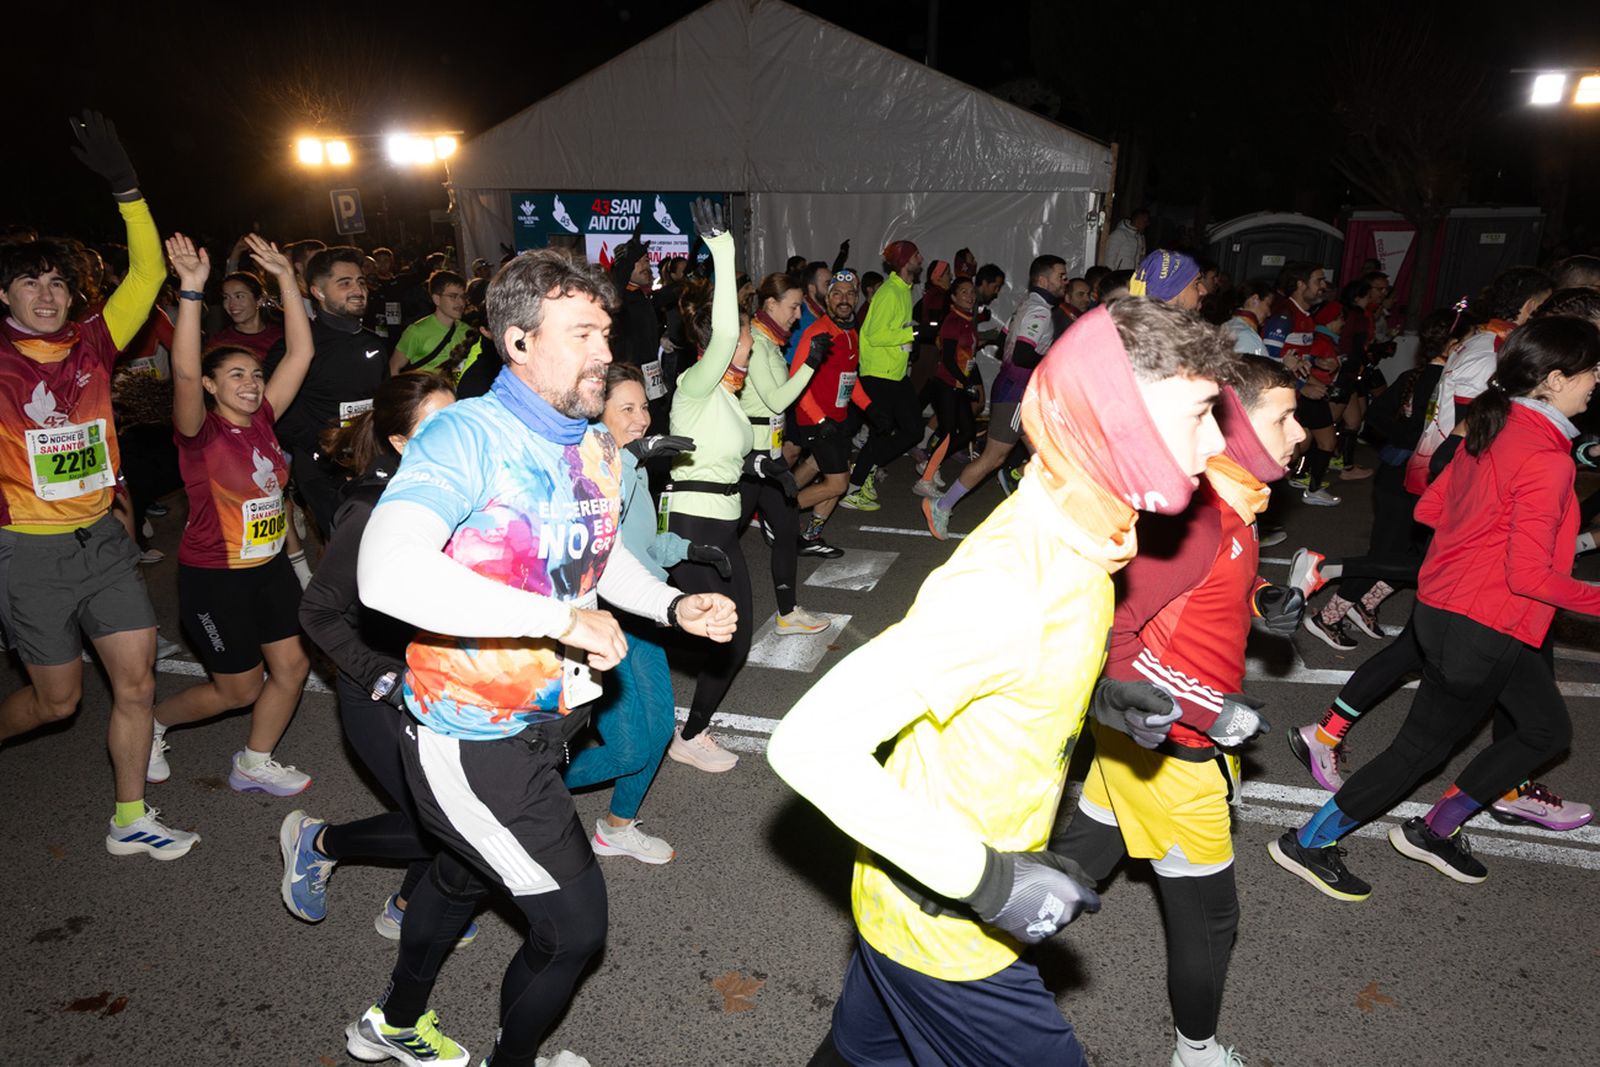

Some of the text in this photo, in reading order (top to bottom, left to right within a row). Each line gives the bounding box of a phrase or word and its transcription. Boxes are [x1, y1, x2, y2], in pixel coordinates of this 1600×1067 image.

[338, 195, 356, 219] P
[592, 198, 641, 215] 43 SAN
[588, 212, 640, 230] ANTÓN
[50, 435, 75, 444] NOCHE
[40, 444, 58, 454] SAN
[593, 517, 613, 536] ES
[537, 522, 589, 560] NO
